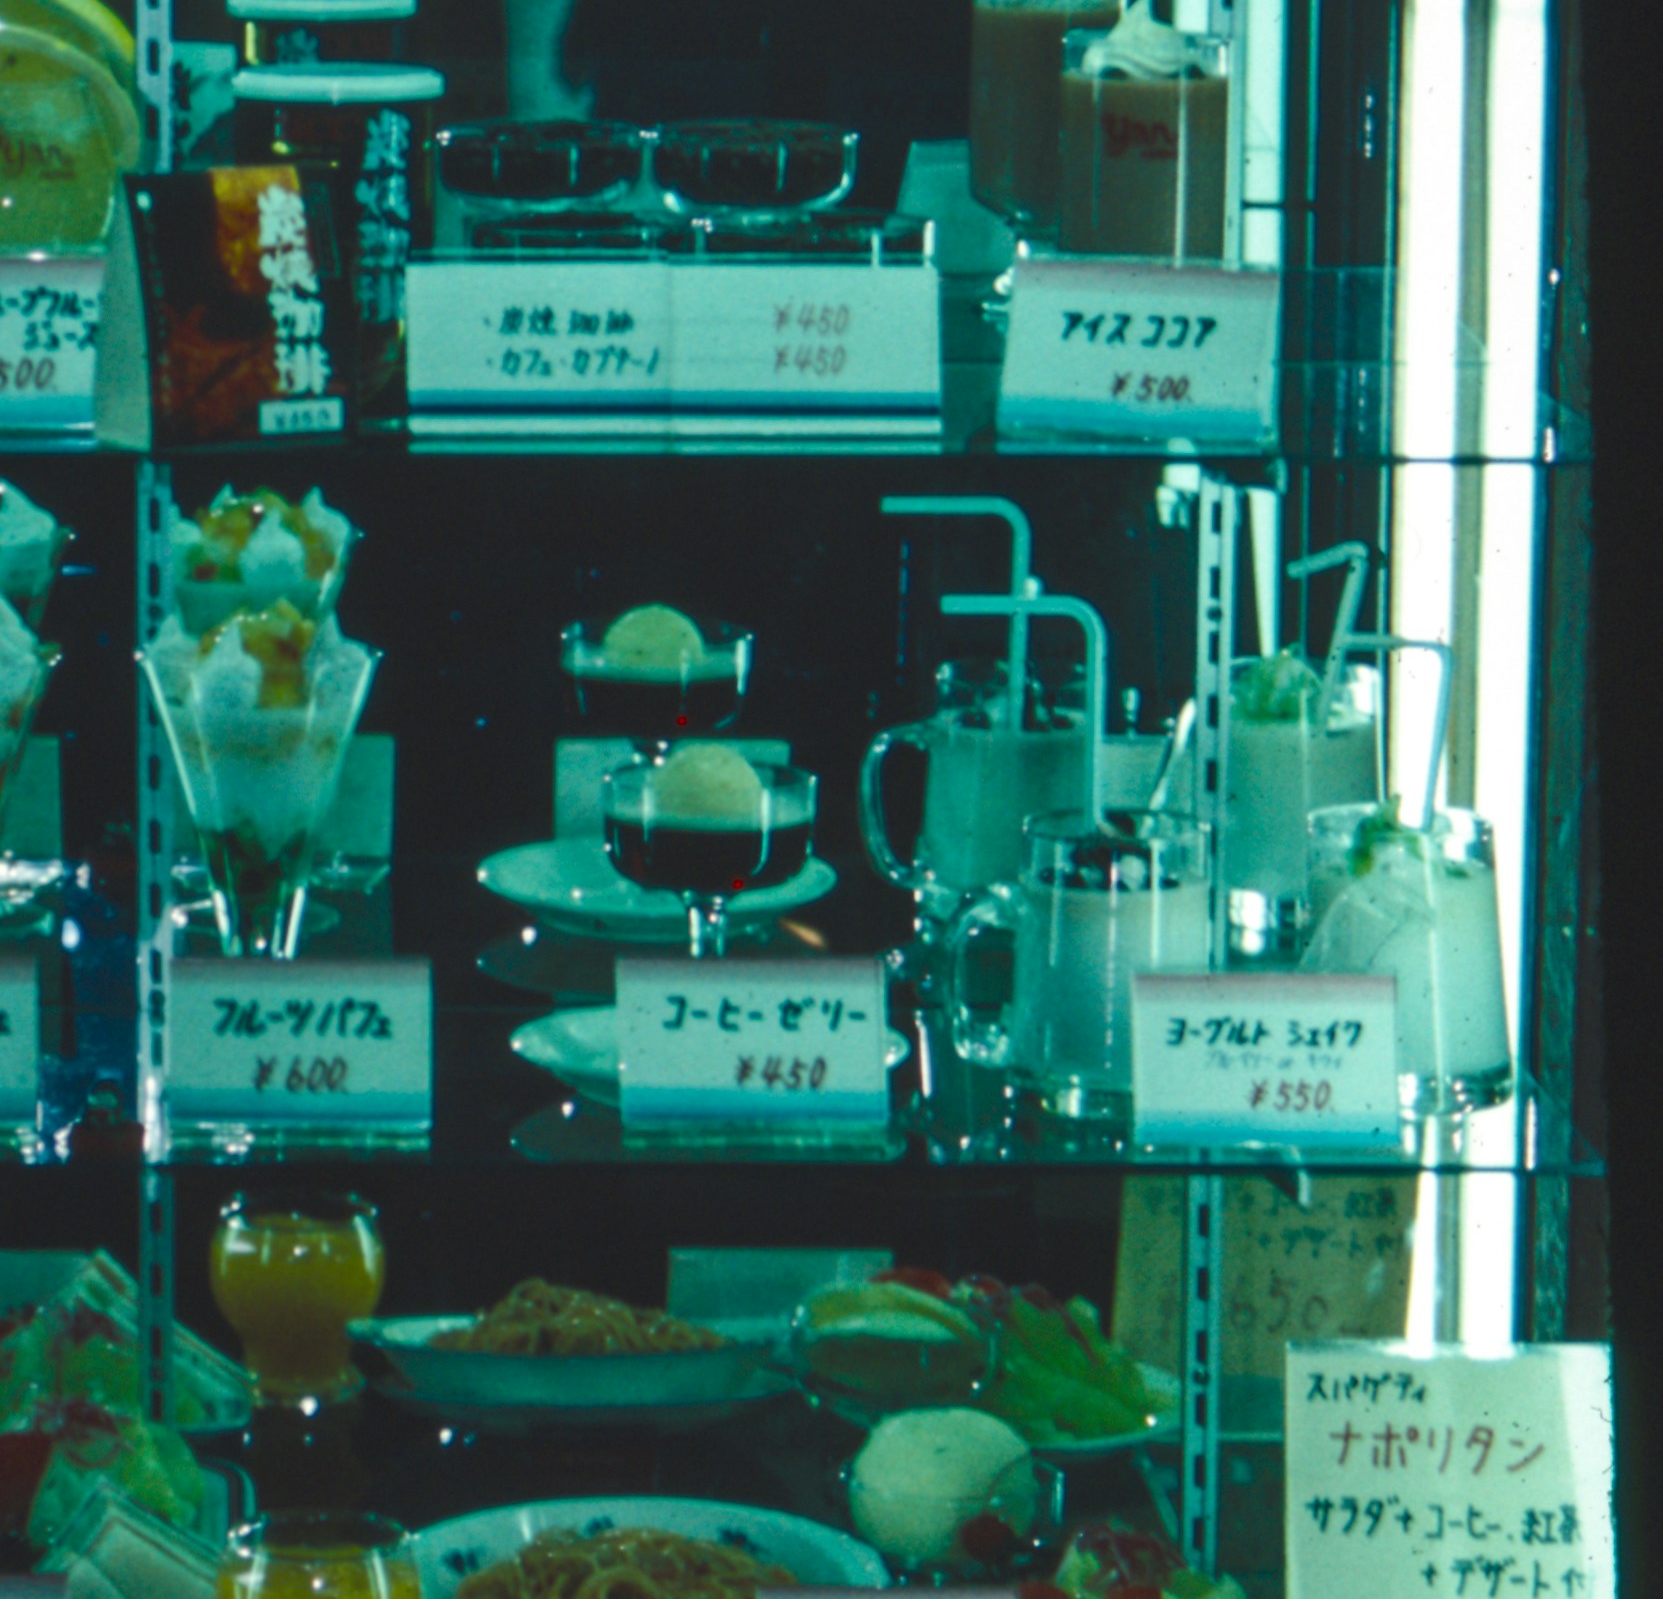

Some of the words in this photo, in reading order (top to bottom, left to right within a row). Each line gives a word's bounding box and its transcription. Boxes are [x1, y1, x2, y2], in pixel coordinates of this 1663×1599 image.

[734, 1055, 828, 1090] ¥450
[1248, 1078, 1333, 1114] ¥550
[1329, 1419, 1546, 1475] ナポリタン
